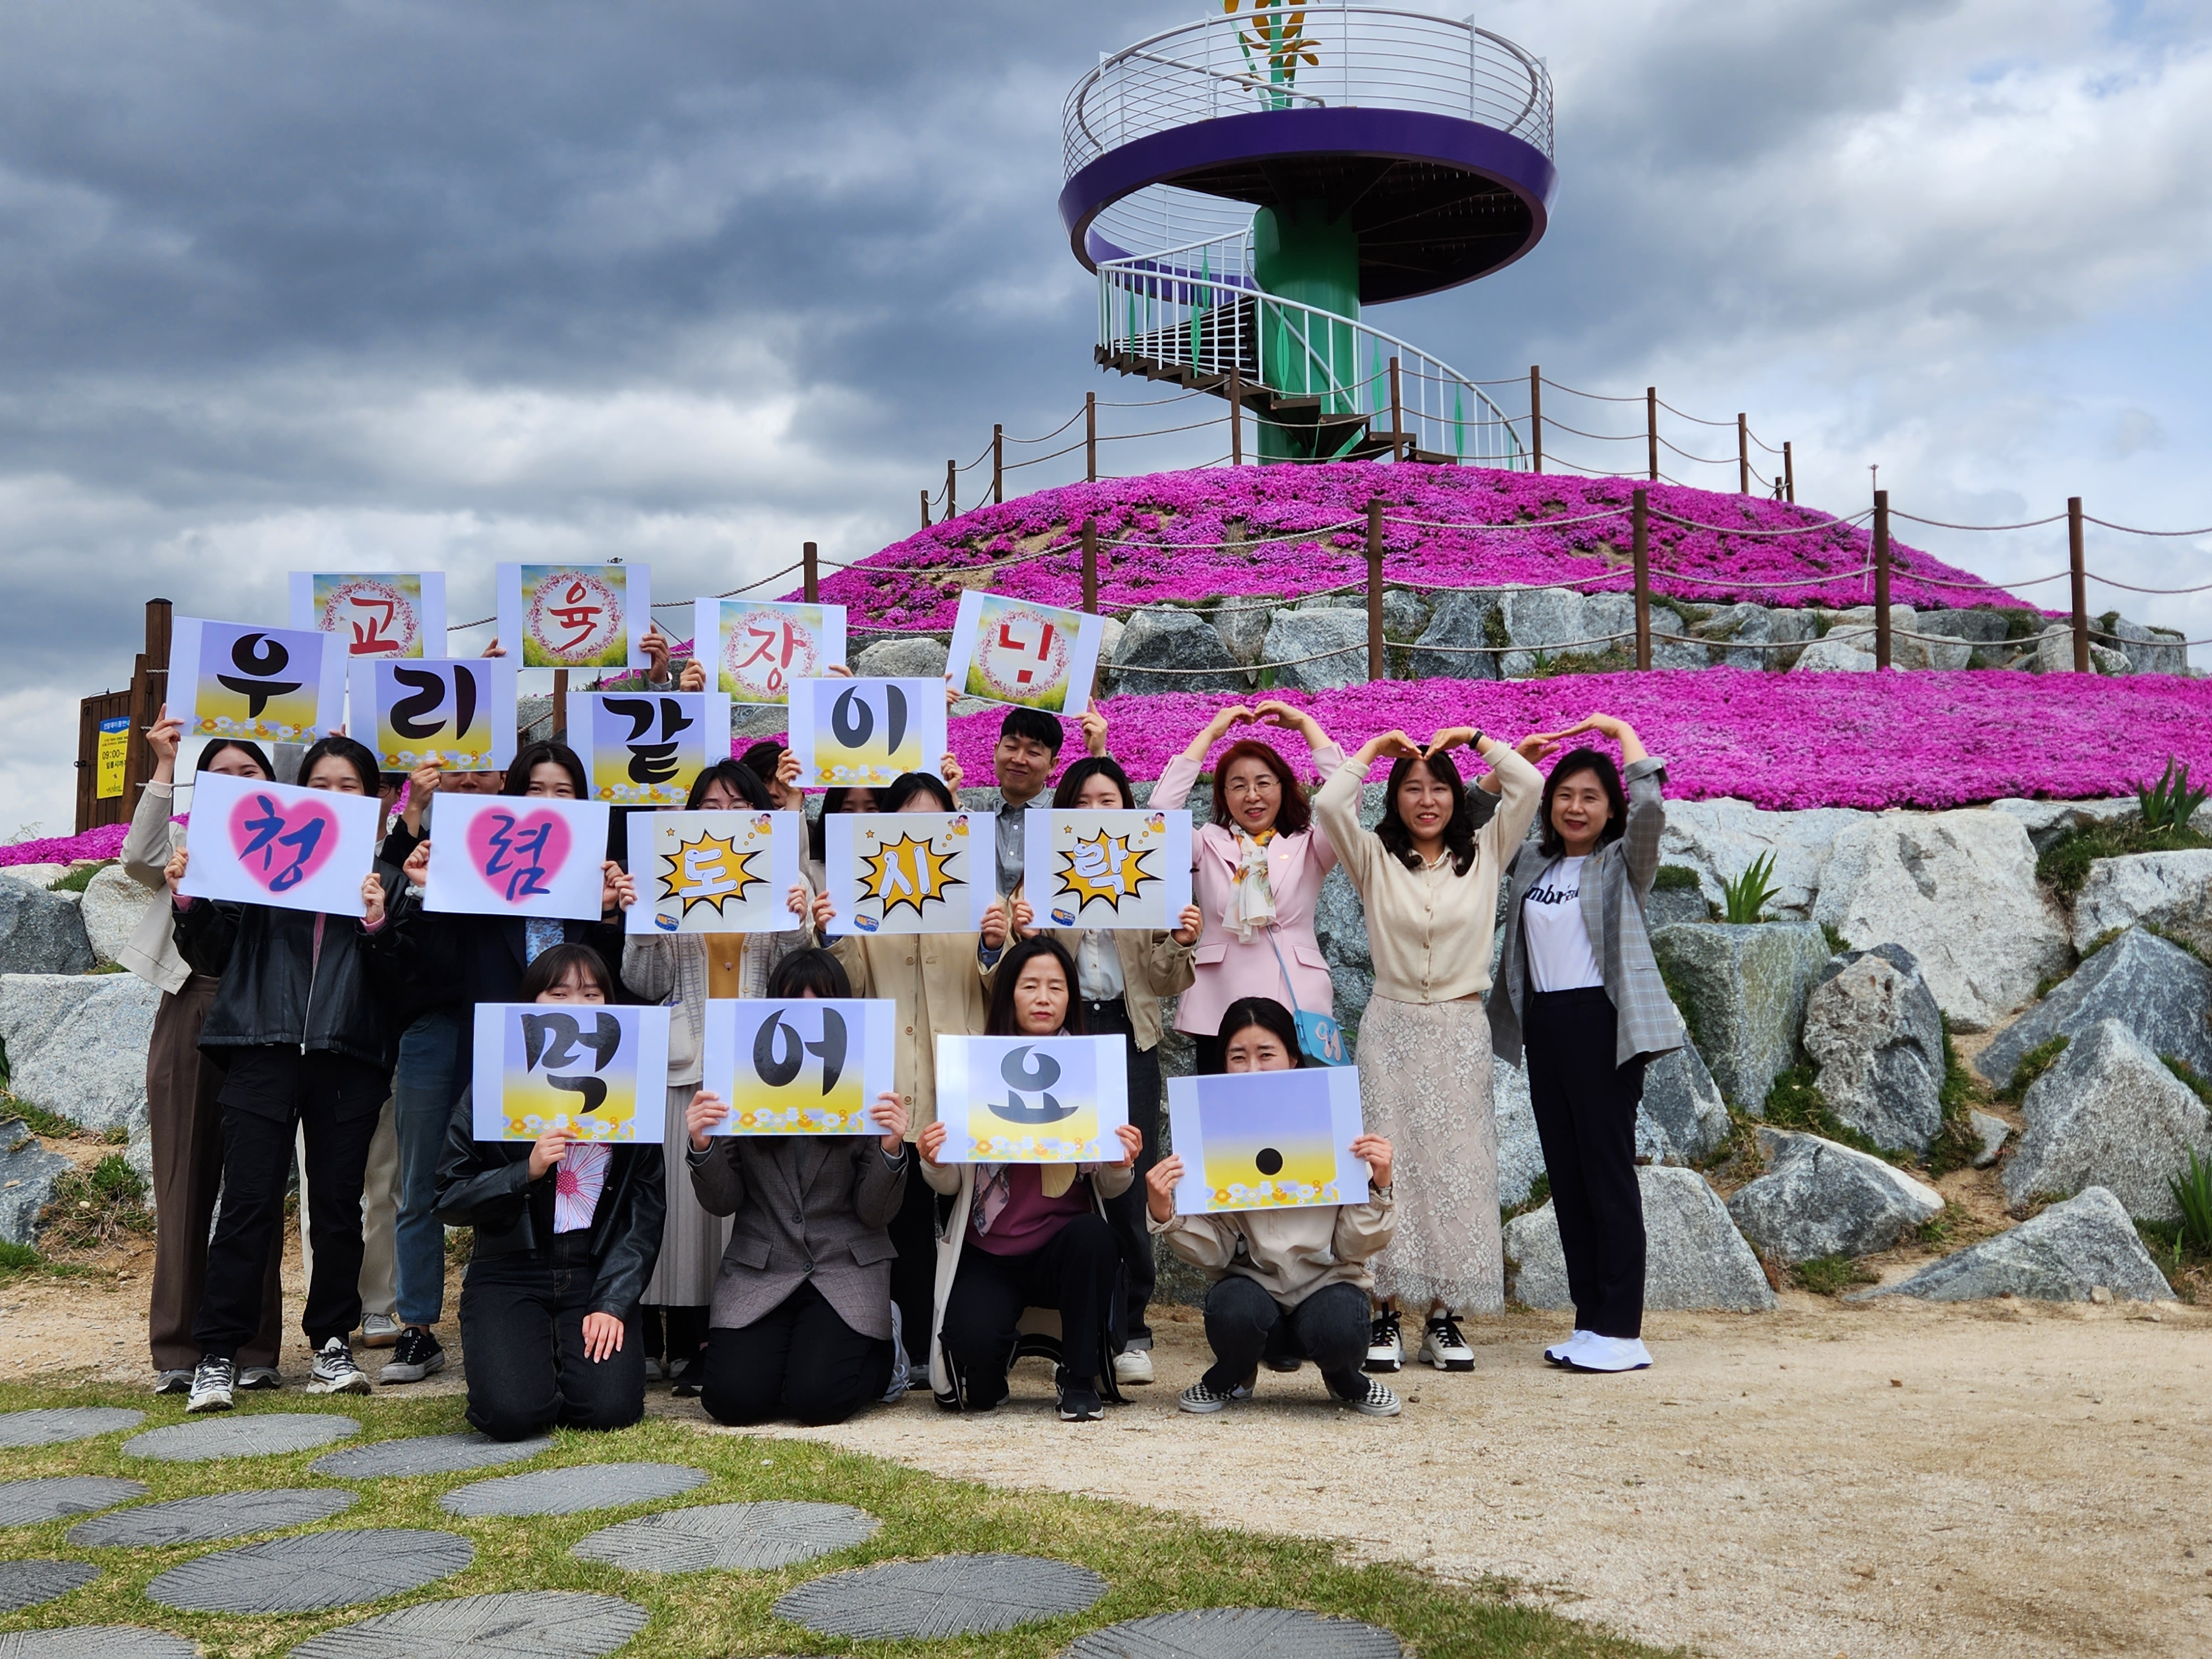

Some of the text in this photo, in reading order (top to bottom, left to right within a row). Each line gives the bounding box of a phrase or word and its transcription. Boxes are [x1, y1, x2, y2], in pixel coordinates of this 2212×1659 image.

[348, 597, 400, 655] 교
[550, 581, 603, 653] 육
[998, 623, 1053, 684] 님
[216, 633, 303, 718] 우
[735, 622, 807, 691] 장
[389, 664, 477, 740] 리
[831, 685, 907, 757] 이
[602, 696, 695, 785] 같
[238, 795, 326, 891] 청
[486, 815, 551, 901] 렴
[679, 848, 738, 899] 도
[878, 845, 931, 899] 시
[1073, 838, 1129, 895] 락
[520, 1011, 622, 1115] 먹
[753, 1008, 848, 1097] 어
[987, 1044, 1079, 1124] 요
